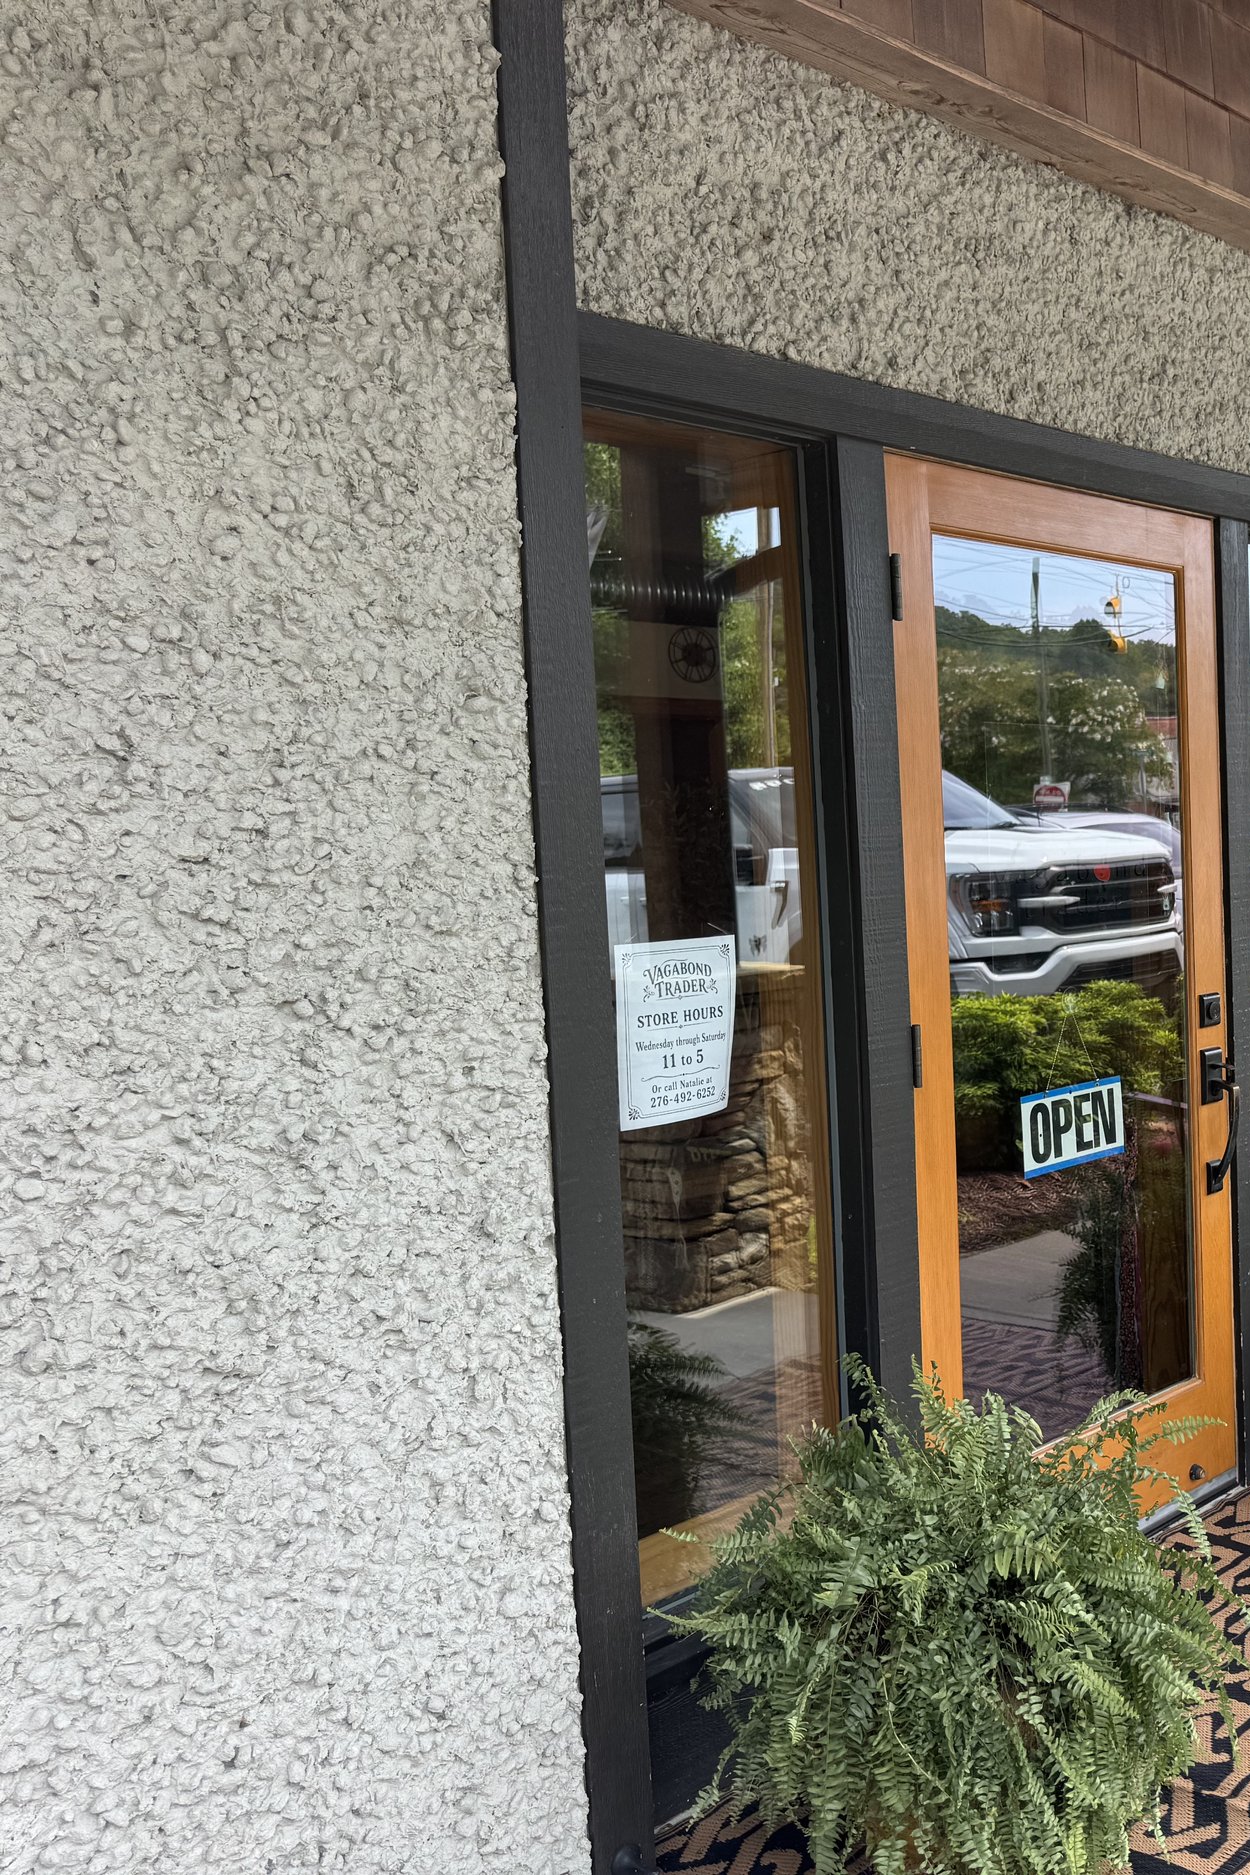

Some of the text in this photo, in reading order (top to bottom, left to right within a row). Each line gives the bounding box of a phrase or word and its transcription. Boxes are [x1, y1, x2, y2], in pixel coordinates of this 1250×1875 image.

[643, 962, 712, 985] VAGABOND
[654, 978, 709, 998] TRADER
[637, 1005, 724, 1029] STORE HOURS
[635, 1030, 727, 1052] Wednesday through Saturday
[662, 1048, 704, 1069] 11 to 5
[651, 1076, 713, 1094] Or call Natalie at
[650, 1085, 716, 1109] 276-492-6252
[1029, 1087, 1117, 1164] OPEN
